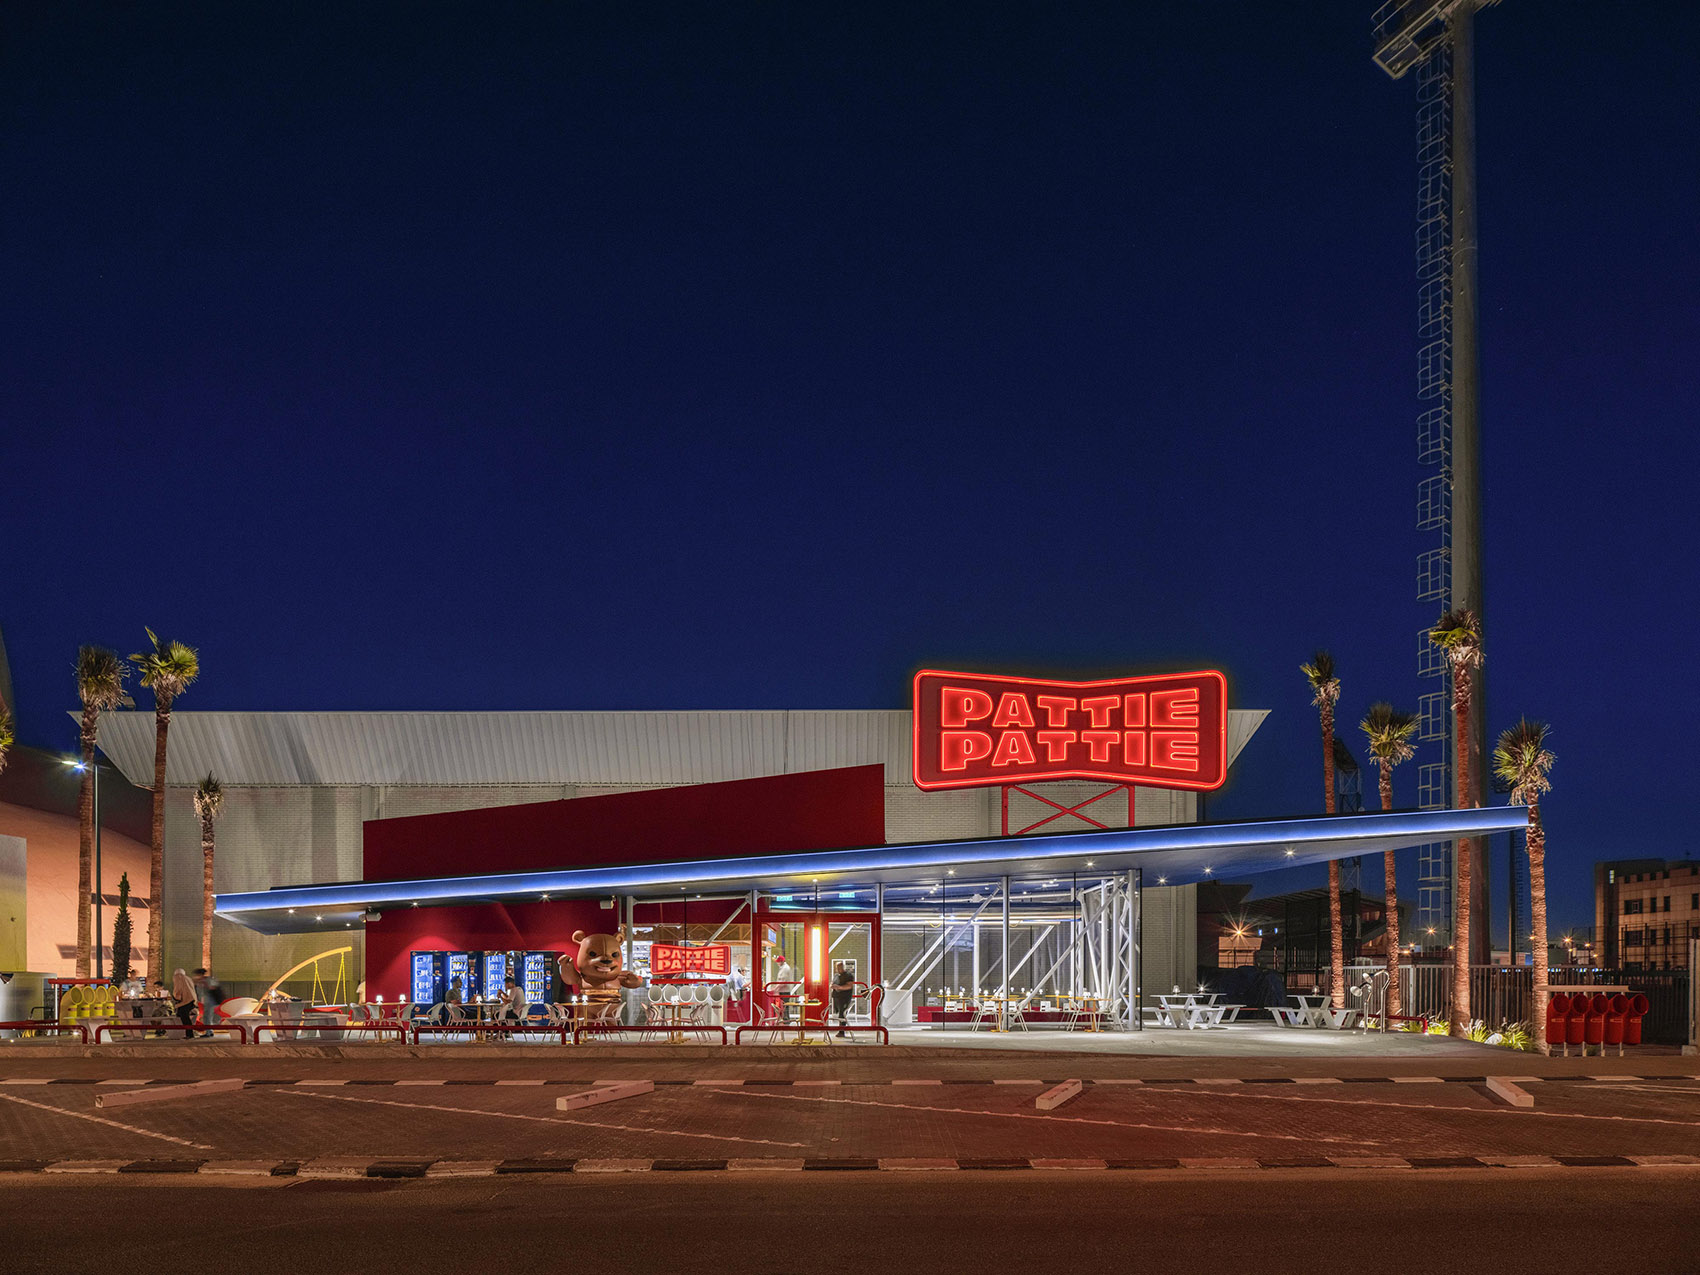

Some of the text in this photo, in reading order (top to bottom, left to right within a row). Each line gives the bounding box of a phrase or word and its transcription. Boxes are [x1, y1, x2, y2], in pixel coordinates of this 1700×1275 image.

[941, 687, 1199, 727] PATTIE
[941, 731, 1199, 771] PATTIE
[657, 948, 724, 959] PATTIE
[657, 960, 724, 970] PATTIE
